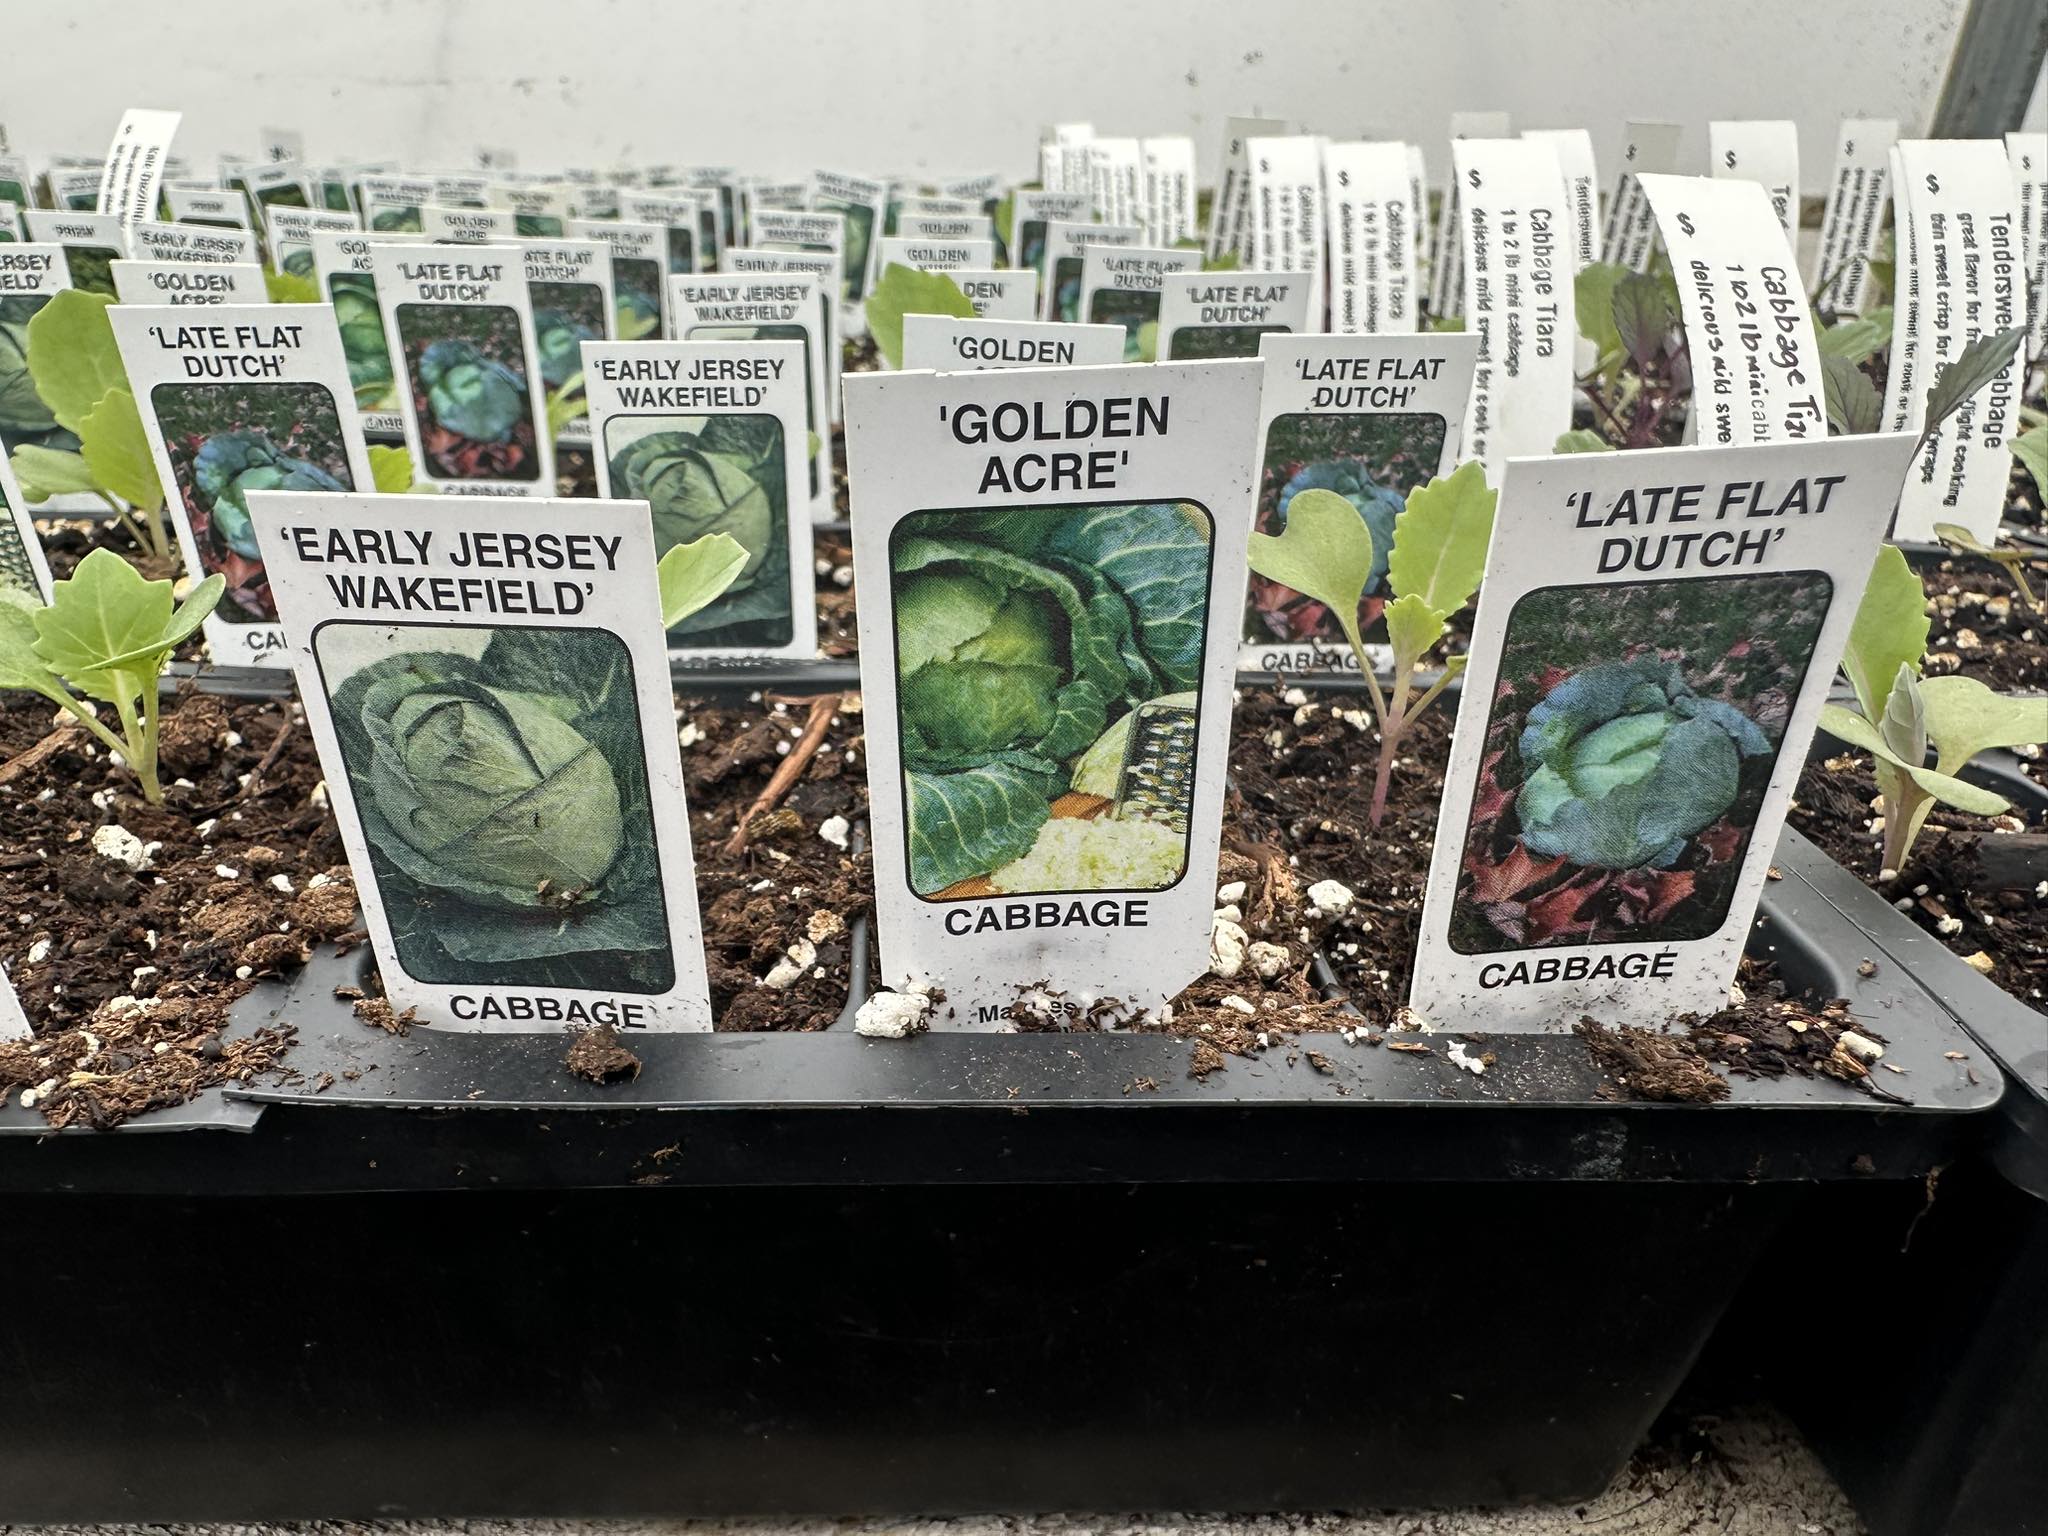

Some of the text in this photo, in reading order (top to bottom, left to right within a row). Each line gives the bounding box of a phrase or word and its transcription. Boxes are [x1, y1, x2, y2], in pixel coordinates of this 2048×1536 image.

[1529, 208, 1558, 358] Cabbage Tiara
[234, 326, 303, 349] FLAT
[1761, 266, 1806, 388] Cabbage
[183, 355, 285, 378] DUTCH’
[952, 336, 1075, 365] 'GOLDEN
[688, 358, 785, 381] JERSEY
[1377, 358, 1447, 381] FLAT
[616, 386, 768, 408] WAKEFIELD’
[1314, 386, 1417, 408] DUTCH’
[940, 396, 1170, 445] 'GOLDEN
[978, 450, 1129, 494] ACRE'
[1566, 475, 1846, 529] ‘LATE FLAT
[280, 527, 622, 572] ‘EARLY JERSEY
[1596, 527, 1787, 575] DUTCH’
[326, 573, 595, 616] WAKEFIELD’
[945, 900, 1149, 936] CABBAGE
[1478, 951, 1678, 990] CABBAGE
[449, 994, 647, 1029] CABBAGE
